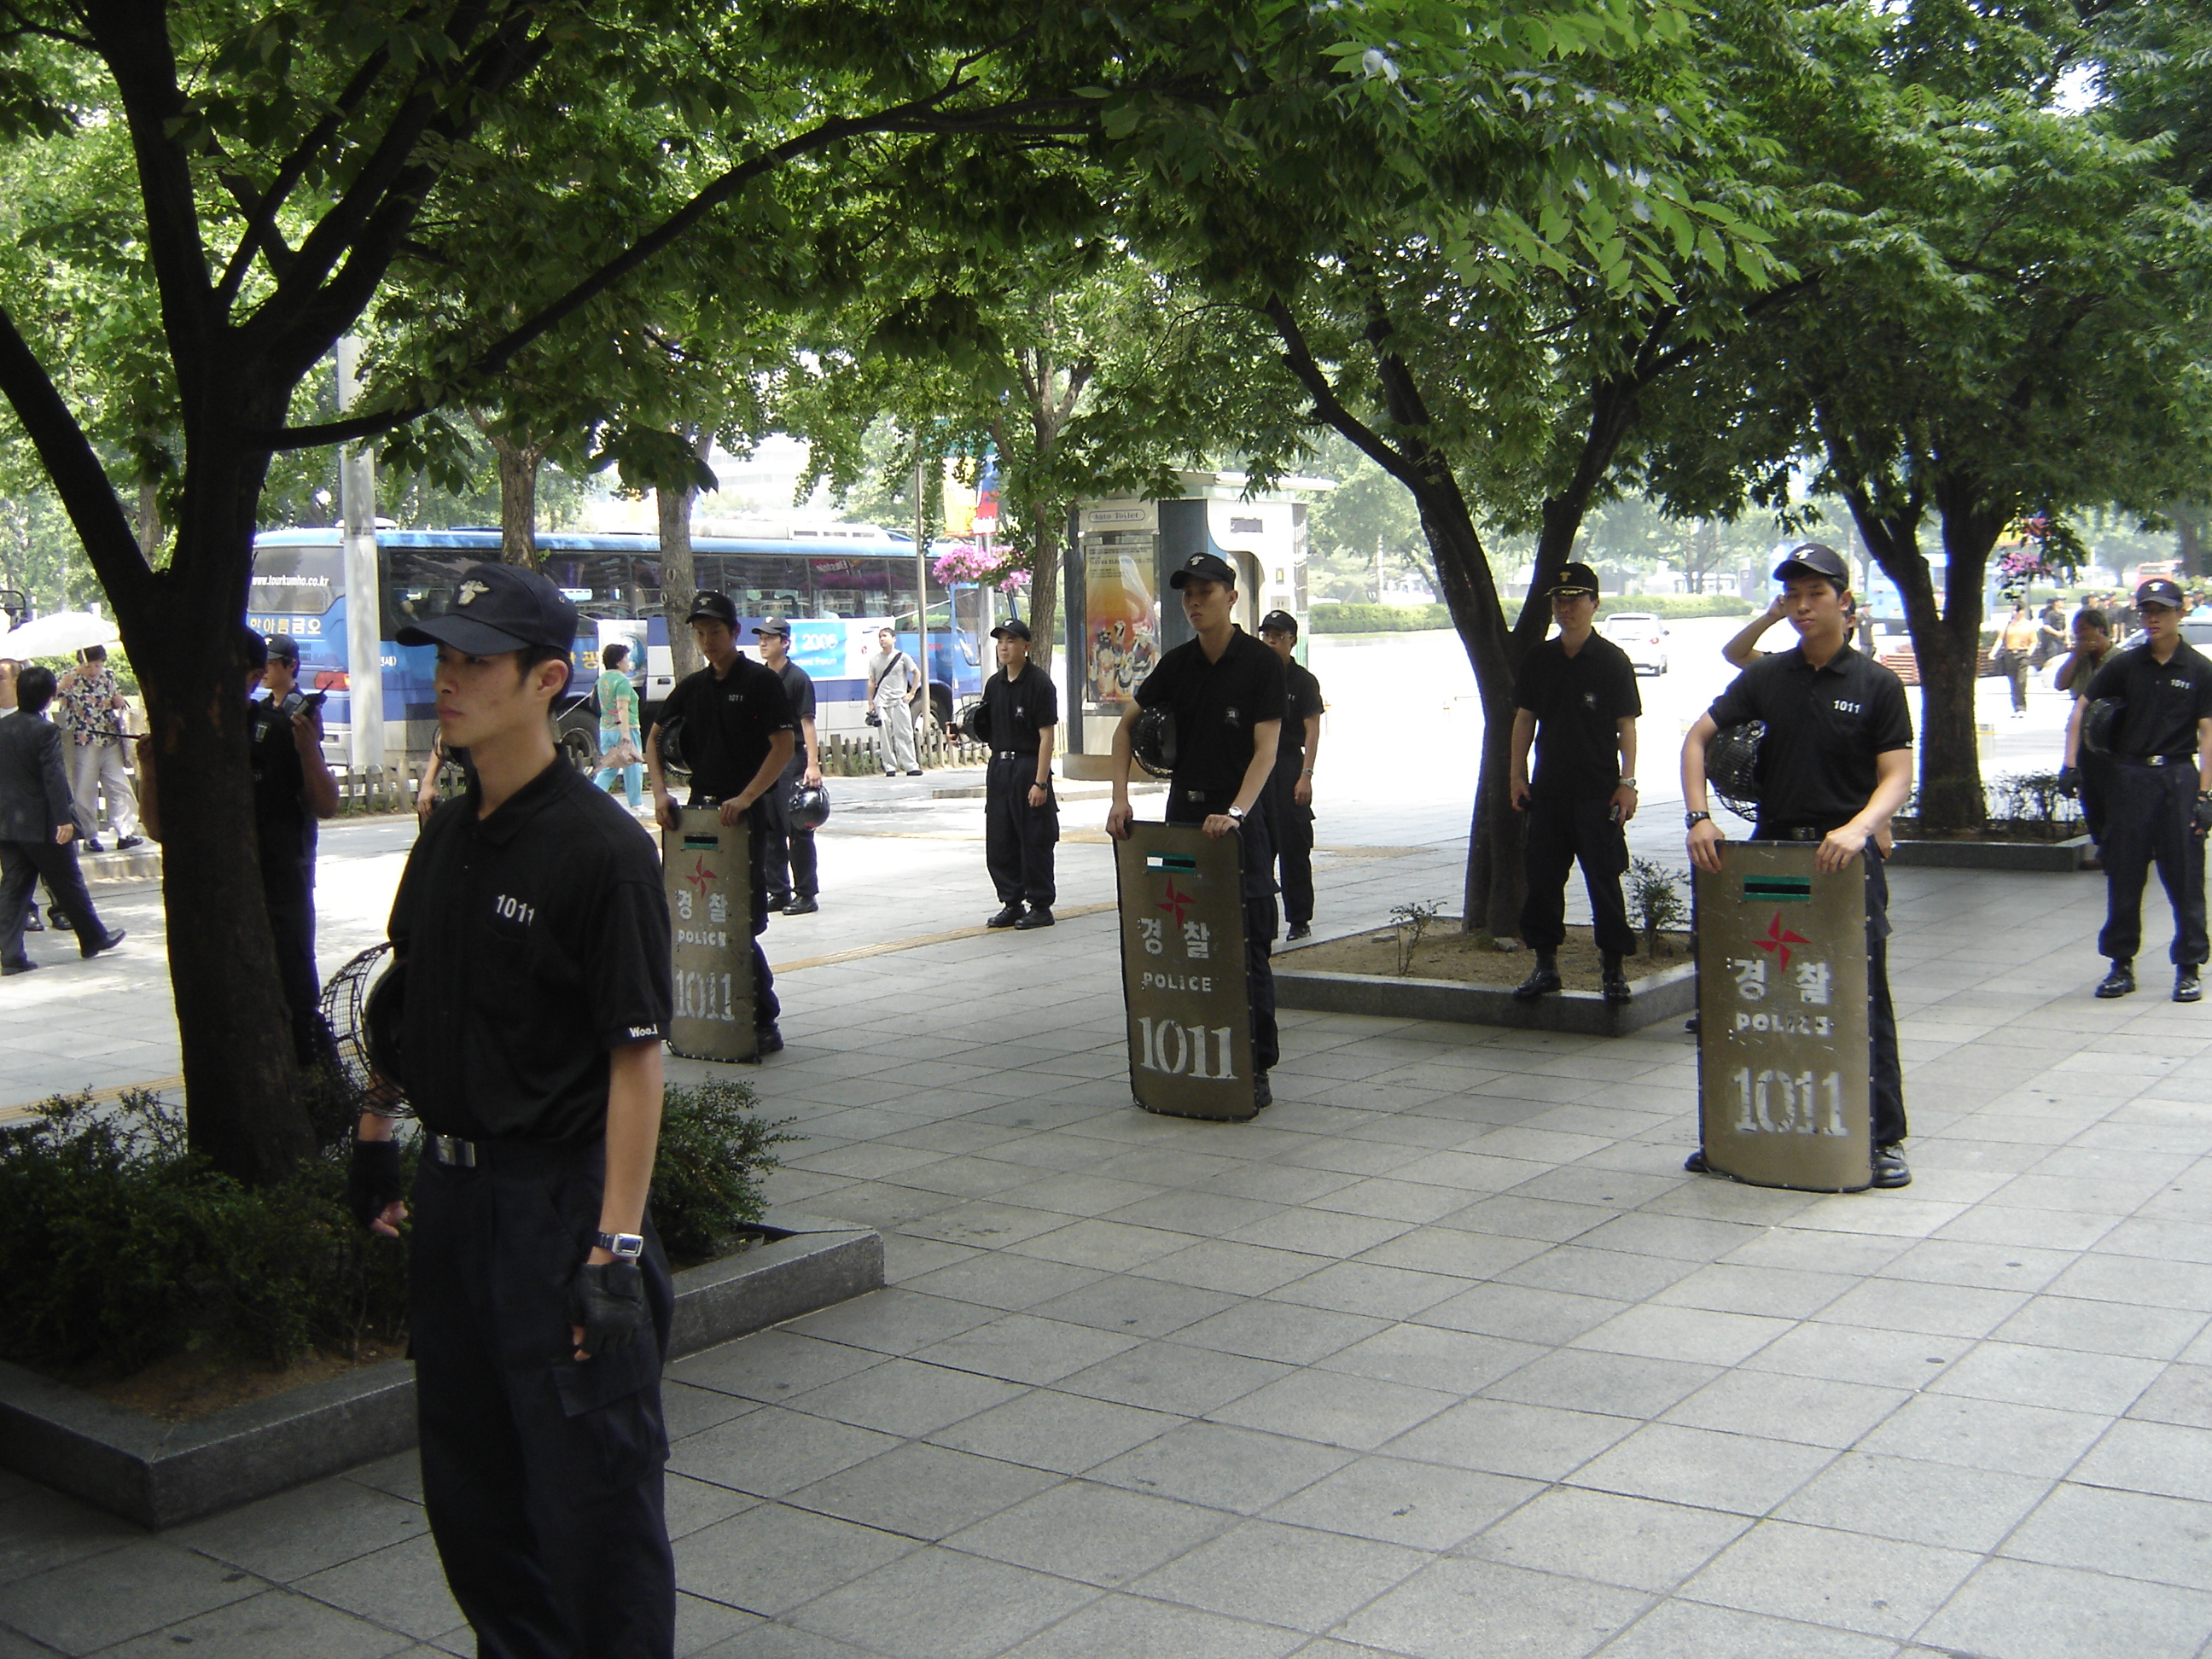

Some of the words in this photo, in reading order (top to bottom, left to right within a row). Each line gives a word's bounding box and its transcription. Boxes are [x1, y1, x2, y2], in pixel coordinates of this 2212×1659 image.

[802, 633, 839, 650] 2005
[1833, 699, 1860, 714] 1011
[496, 894, 535, 927] 1011
[678, 928, 727, 948] POLICE
[676, 969, 735, 1022] 1011
[1138, 1016, 1238, 1080] 1011
[1732, 1066, 1849, 1138] 1011
